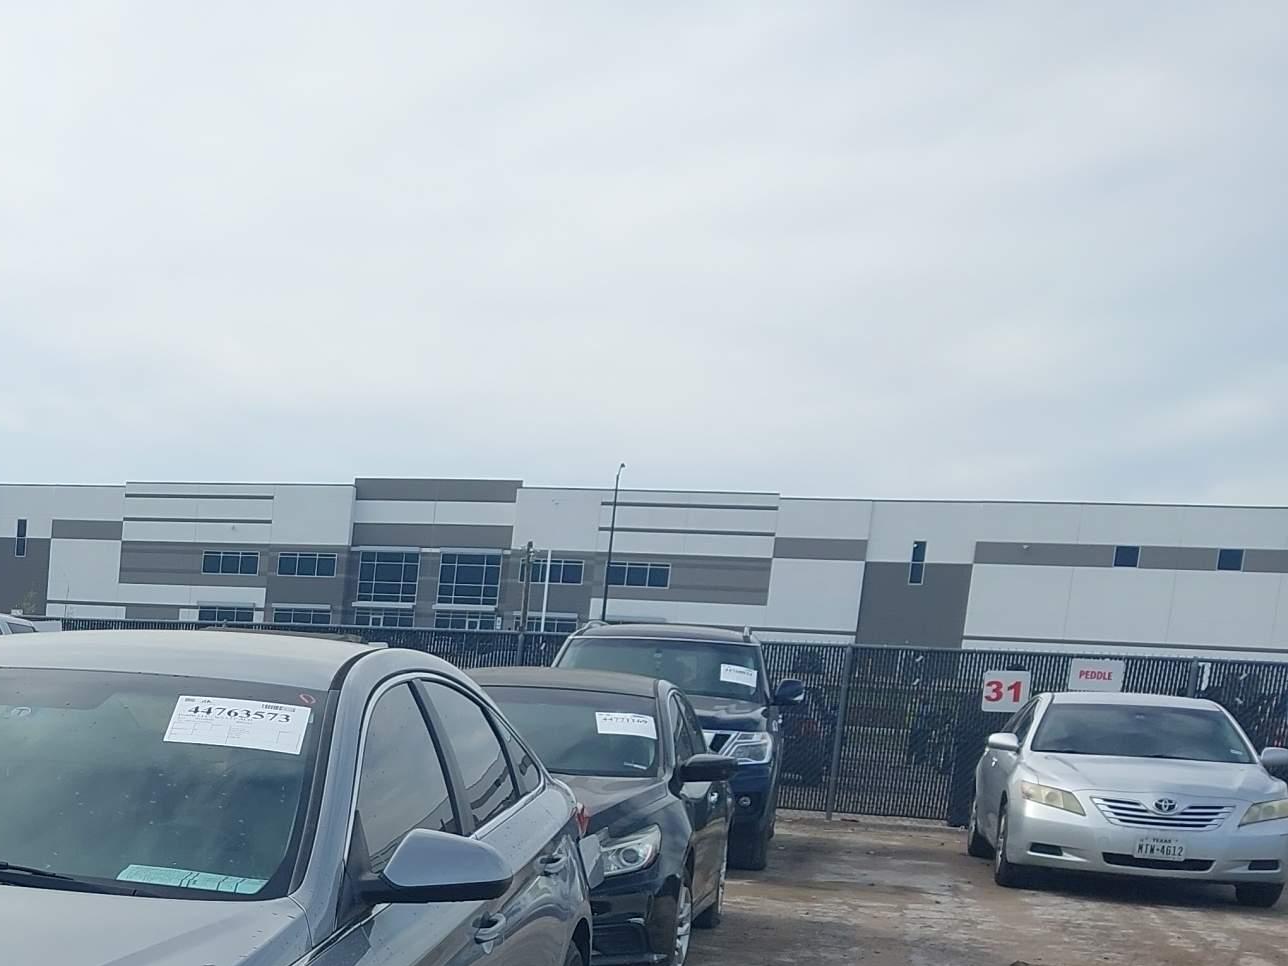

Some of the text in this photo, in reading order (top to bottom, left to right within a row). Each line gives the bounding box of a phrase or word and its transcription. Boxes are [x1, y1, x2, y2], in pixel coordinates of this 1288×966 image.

[1078, 669, 1113, 681] PEDDLE
[984, 680, 1023, 703] 31
[187, 705, 291, 723] 44763573
